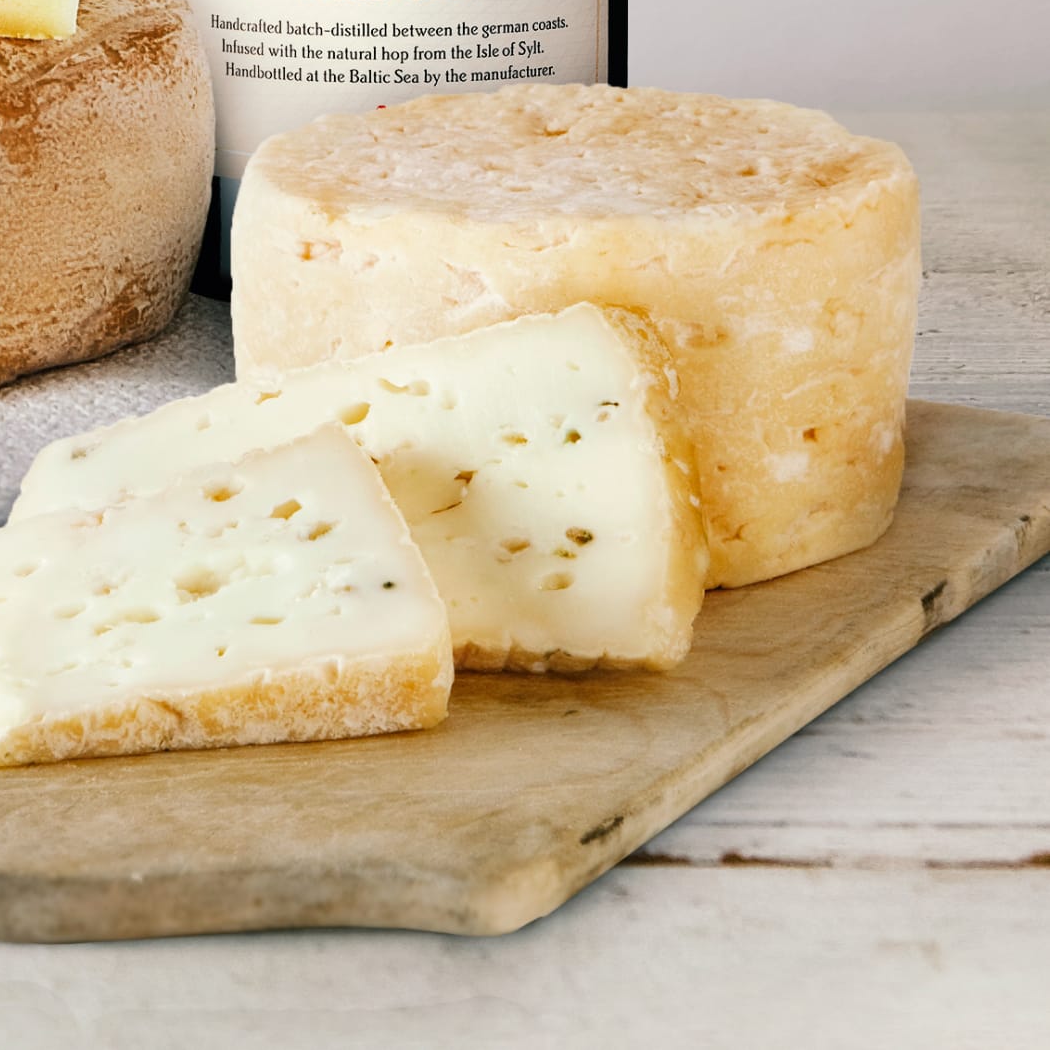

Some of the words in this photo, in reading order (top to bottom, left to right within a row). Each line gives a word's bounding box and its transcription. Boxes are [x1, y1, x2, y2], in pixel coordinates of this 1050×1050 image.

[211, 14, 282, 33] Handcrafted
[287, 21, 387, 37] batch-distilled
[392, 23, 452, 37] between
[457, 22, 478, 35] the
[482, 21, 528, 38] german
[532, 17, 568, 31] coasts.
[222, 39, 264, 55] Infused
[269, 44, 296, 58] with
[302, 45, 323, 59] the
[328, 47, 376, 60] natural
[382, 47, 408, 63] hop
[414, 46, 446, 60] from
[452, 45, 472, 59] the
[477, 44, 498, 58] Isle
[502, 42, 515, 56] of
[518, 41, 544, 58] Sylt.
[226, 63, 302, 81] Handbottled
[306, 70, 318, 82] at
[323, 69, 345, 82] the
[350, 69, 390, 83] Baltic
[394, 69, 419, 83] Sea
[424, 70, 440, 86] by
[446, 69, 467, 82] the
[471, 65, 555, 81] manufacturer.
